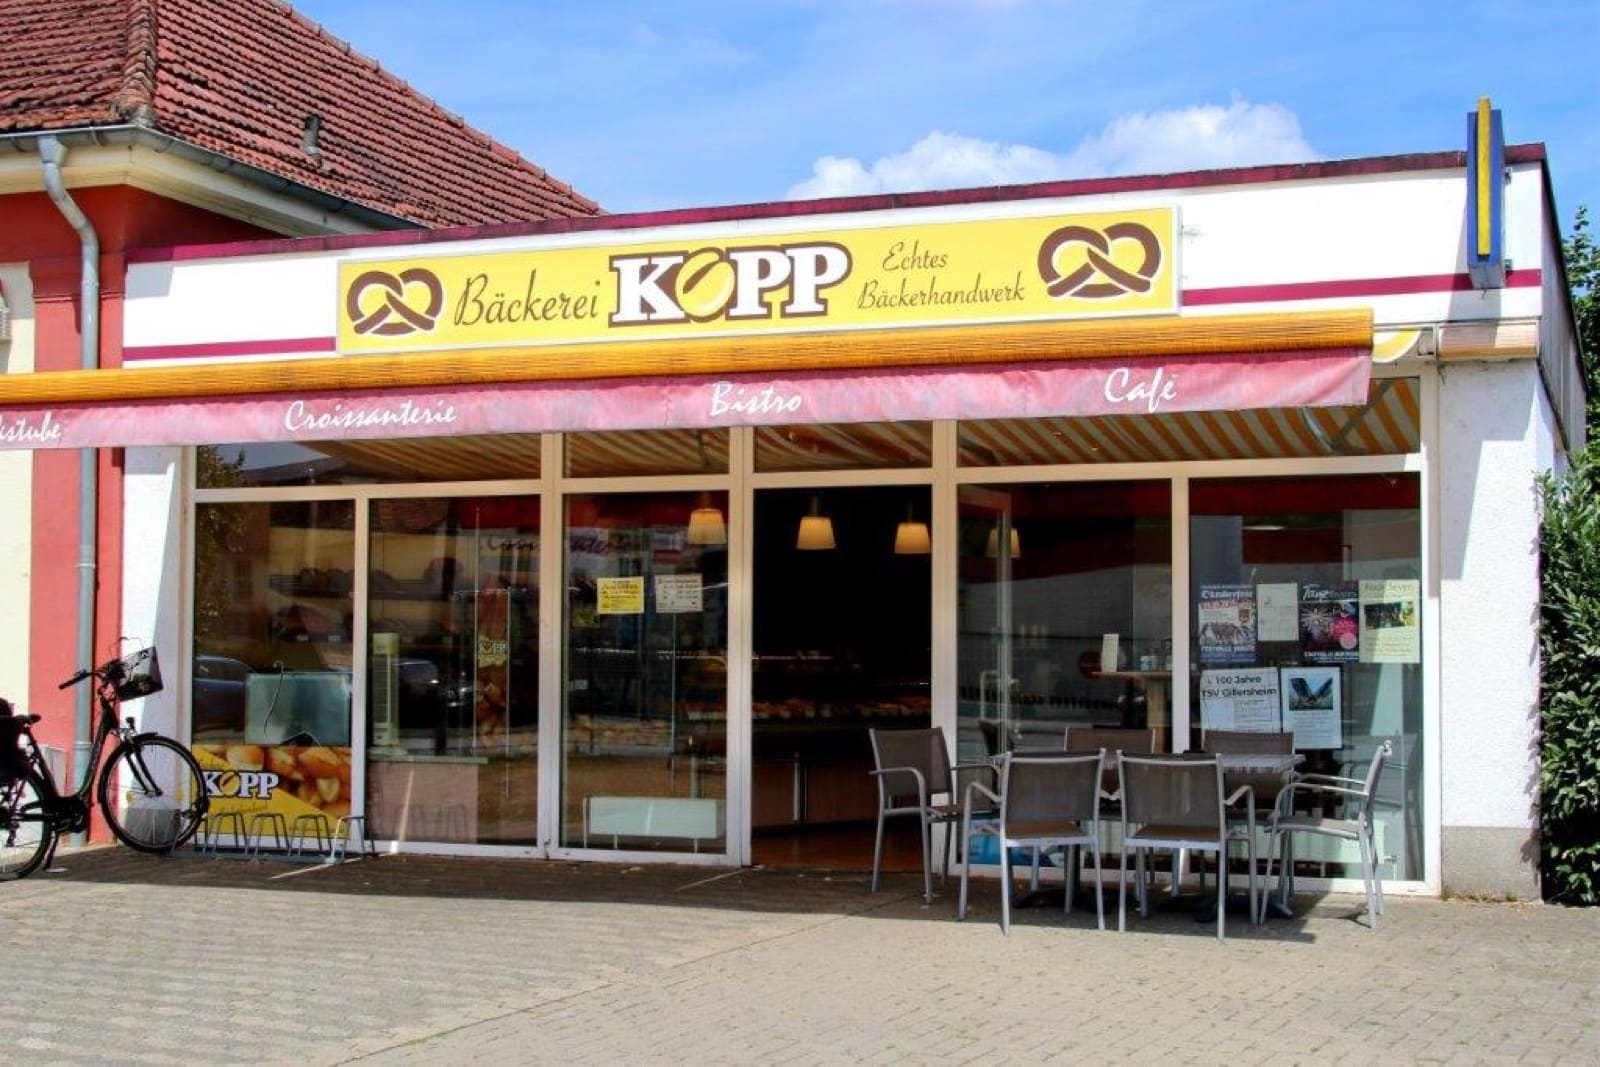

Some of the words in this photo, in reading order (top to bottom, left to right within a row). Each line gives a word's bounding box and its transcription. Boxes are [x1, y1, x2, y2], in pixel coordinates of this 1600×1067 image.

[882, 241, 949, 272] Echtes
[454, 268, 601, 326] Bäckerei
[608, 241, 853, 327] KOPP
[857, 272, 1026, 311] Bäckerhandwerk
[709, 381, 802, 418] Bistro
[1105, 366, 1177, 413] Café
[284, 399, 457, 432] Croissanterie
[203, 770, 280, 799] KOPP
